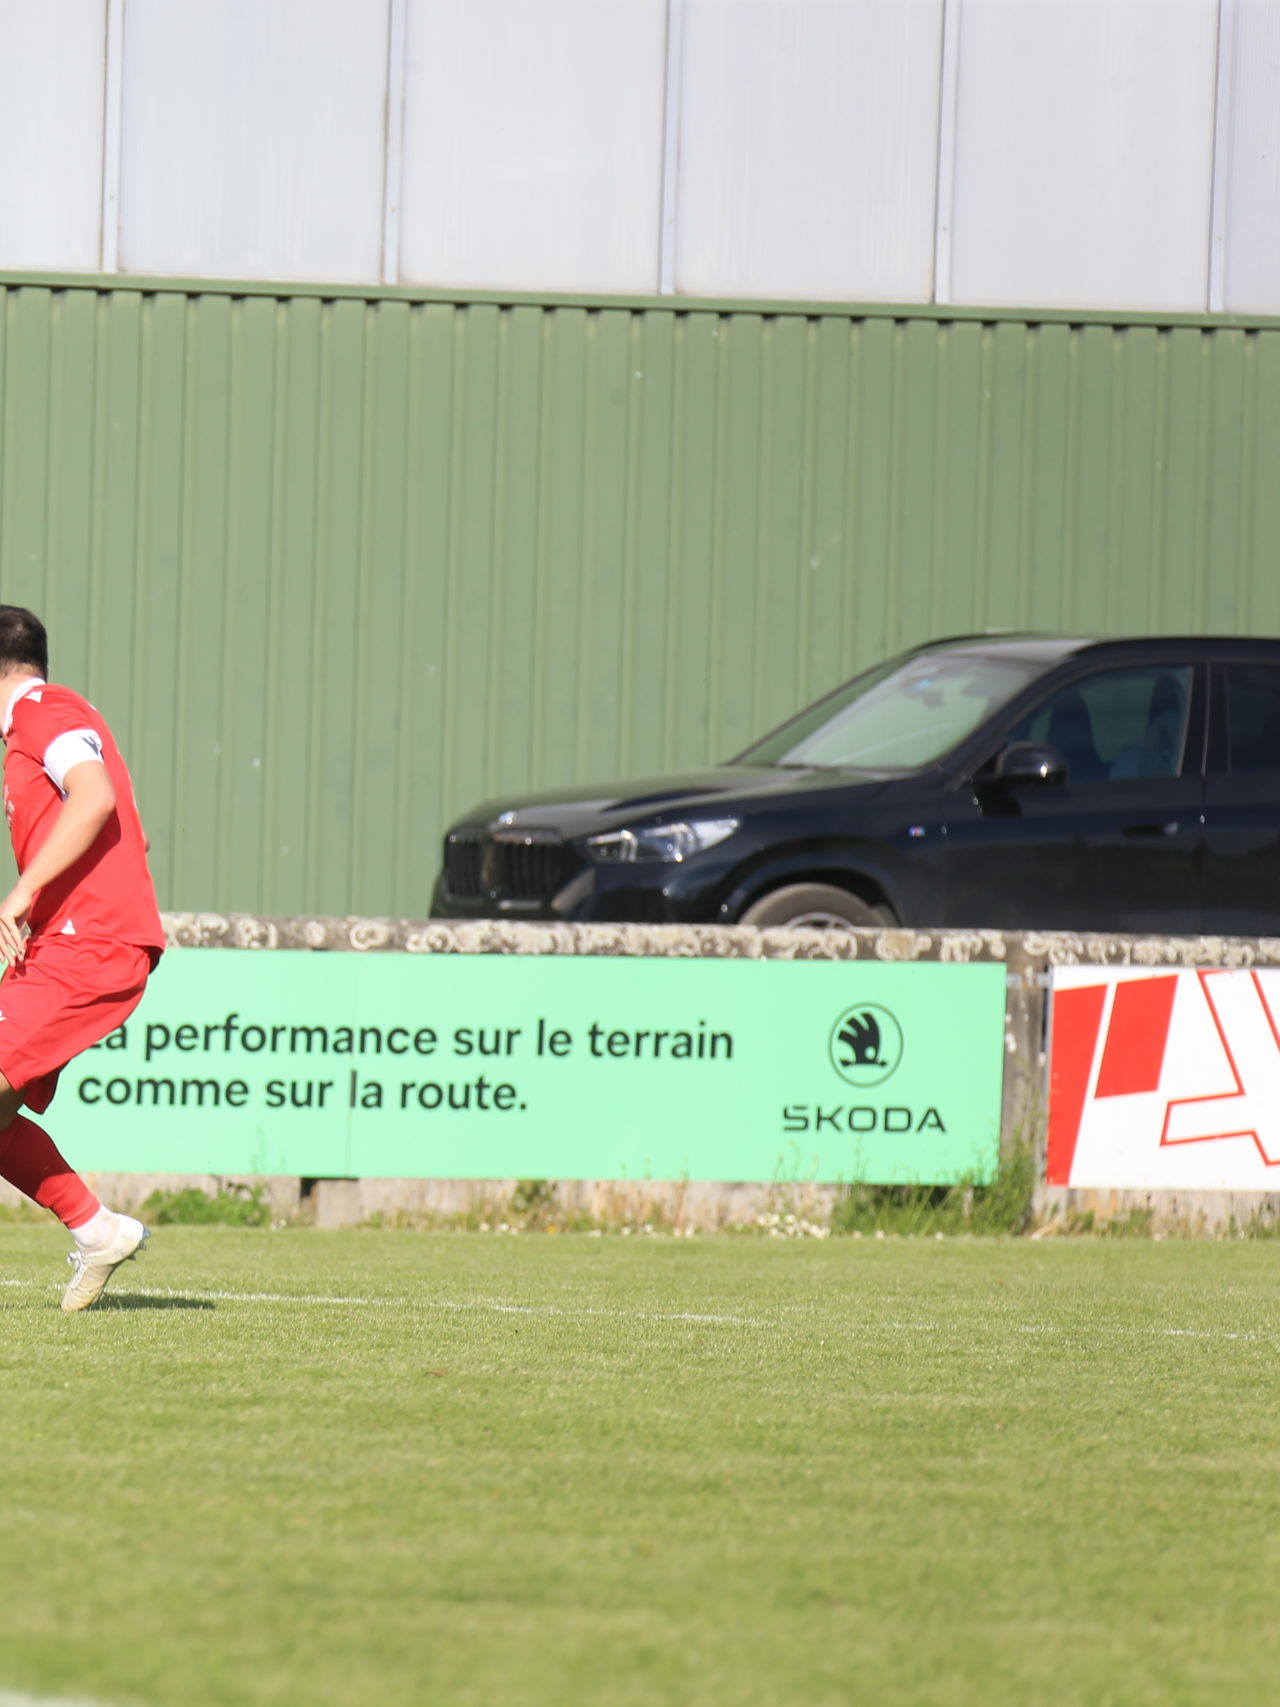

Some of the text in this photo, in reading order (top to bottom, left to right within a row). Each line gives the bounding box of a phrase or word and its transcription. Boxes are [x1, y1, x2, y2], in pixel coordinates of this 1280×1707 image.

[145, 1014, 438, 1062] performance
[453, 1026, 522, 1056] sur
[537, 1018, 573, 1056] le
[588, 1020, 734, 1060] terrain
[78, 1070, 528, 1111] comme sur la route.
[782, 1106, 947, 1134] SKODA
